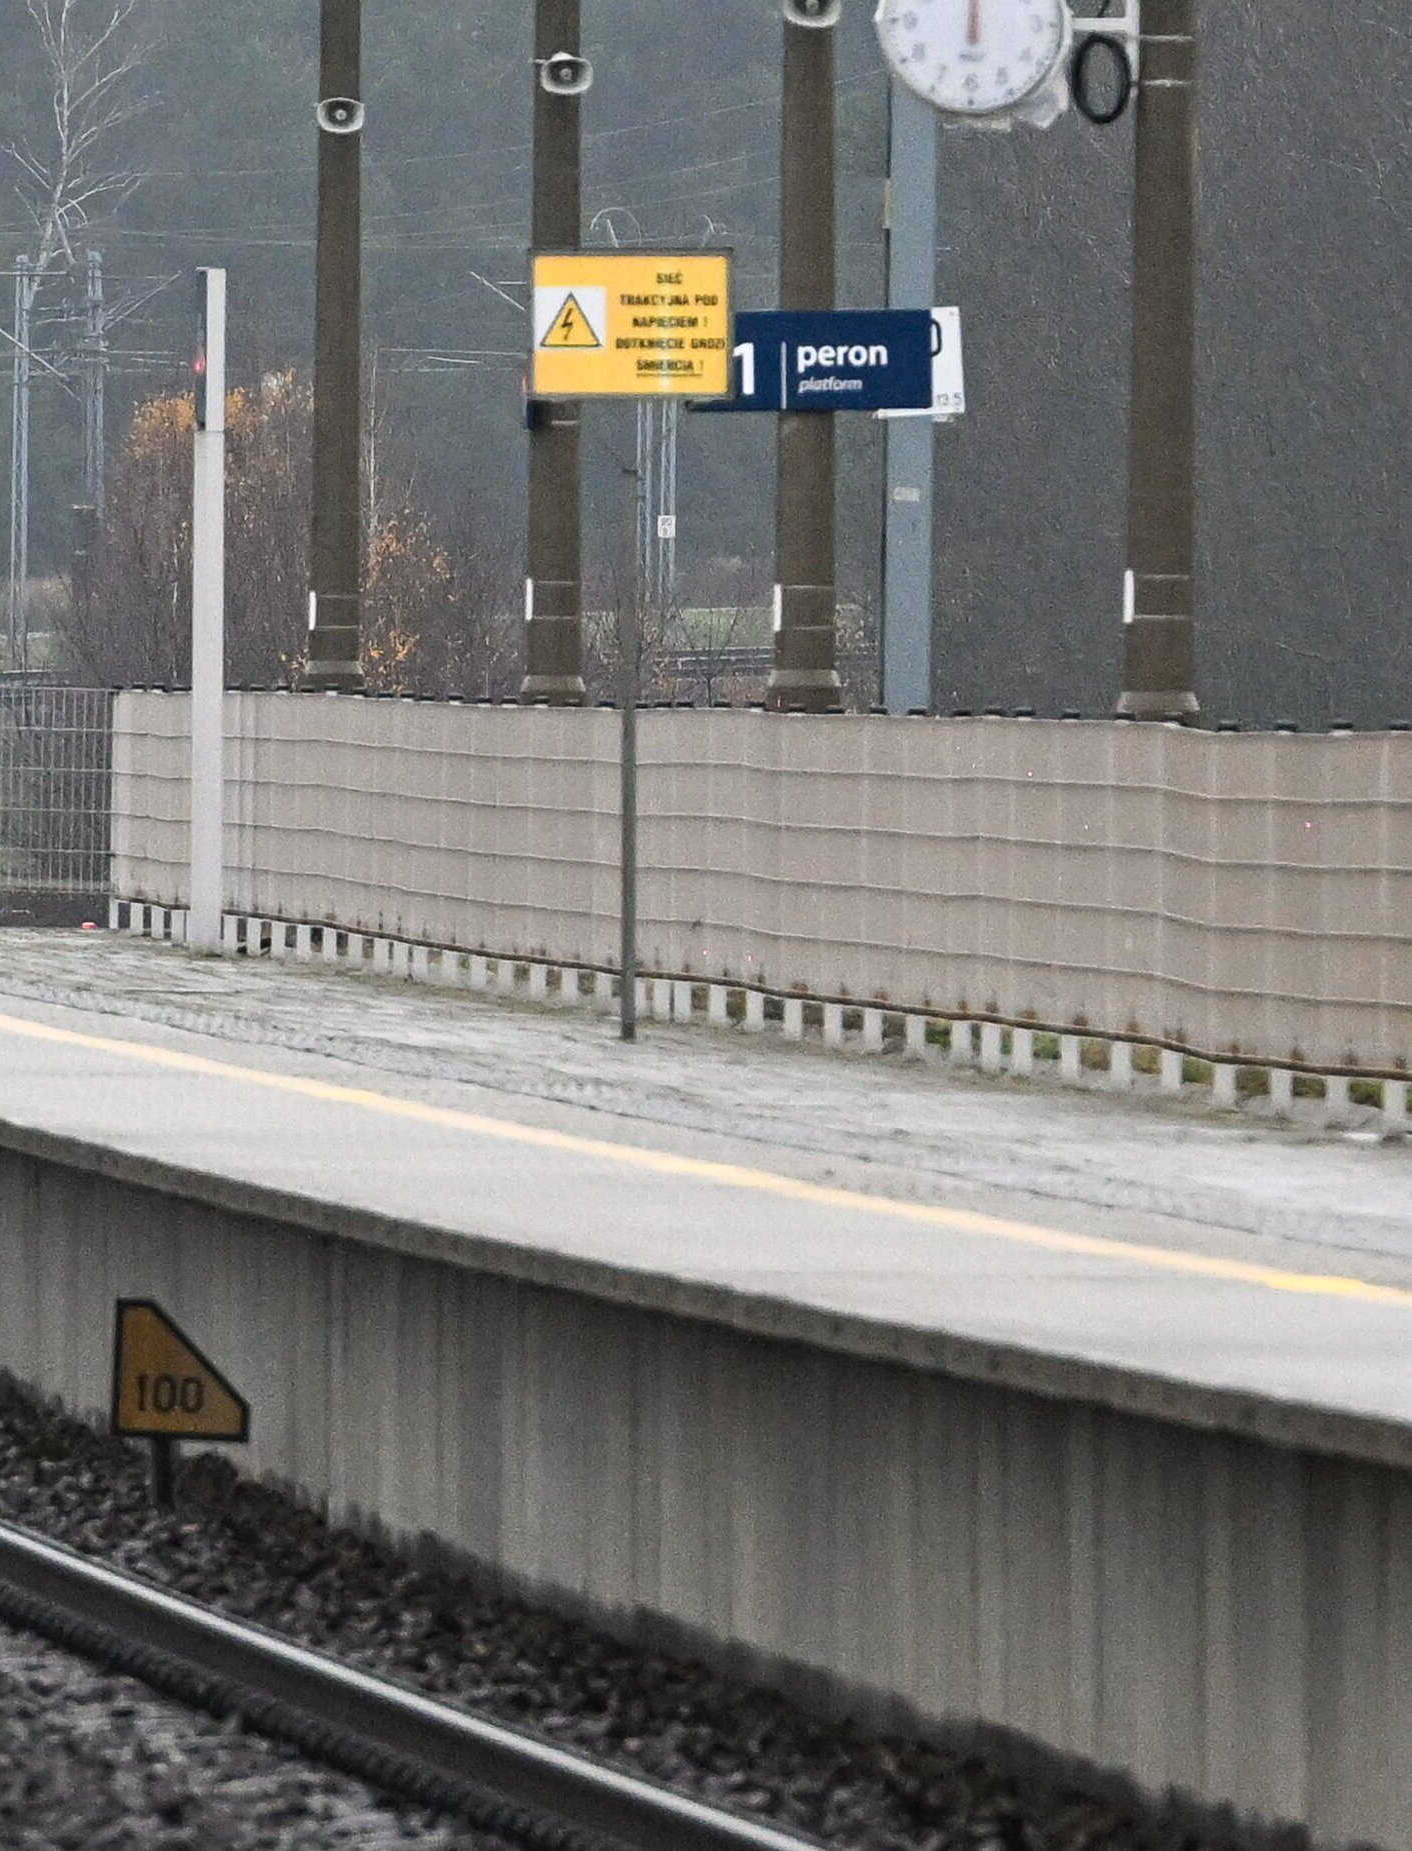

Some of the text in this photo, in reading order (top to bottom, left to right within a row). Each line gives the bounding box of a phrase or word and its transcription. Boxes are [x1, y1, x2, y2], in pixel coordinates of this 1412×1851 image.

[733, 341, 888, 395] 1 peron
[798, 376, 863, 394] platform
[137, 1373, 205, 1413] 100
